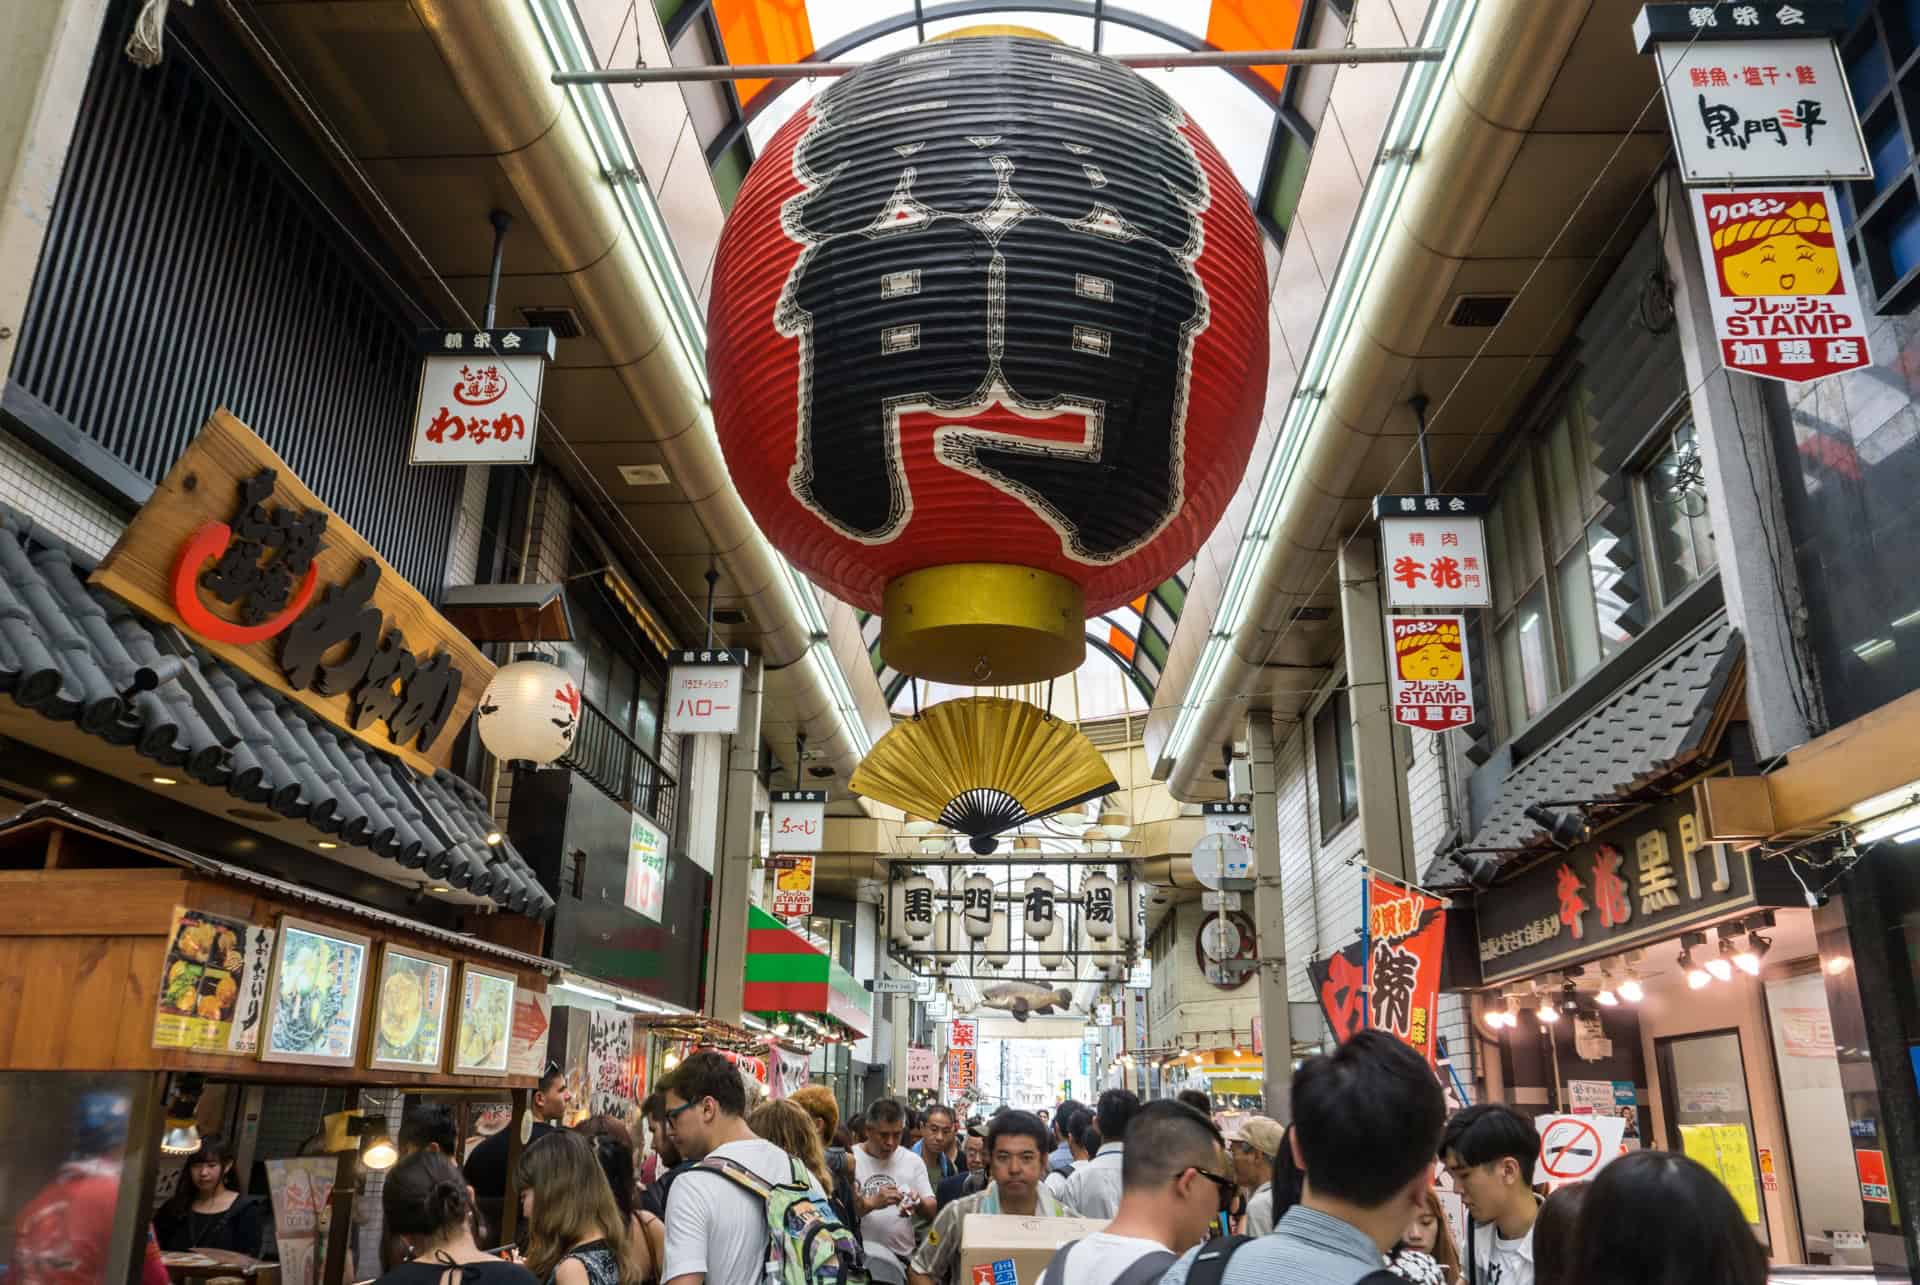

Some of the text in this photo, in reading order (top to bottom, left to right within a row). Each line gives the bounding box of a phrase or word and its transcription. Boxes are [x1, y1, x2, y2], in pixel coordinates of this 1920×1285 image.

[1710, 198, 1785, 224] クロモン
[1733, 298, 1833, 316] フレッシュ
[1727, 315, 1853, 337] STAMP
[1731, 341, 1859, 365] 加盟店
[425, 407, 525, 445] わなか
[1395, 620, 1438, 635] クロモン
[1403, 680, 1458, 692] フレッシュ
[1399, 691, 1468, 704] STAMP
[676, 699, 731, 717] ハロー
[1400, 707, 1469, 722] 加盟店
[903, 886, 1114, 924] 黒門市場
